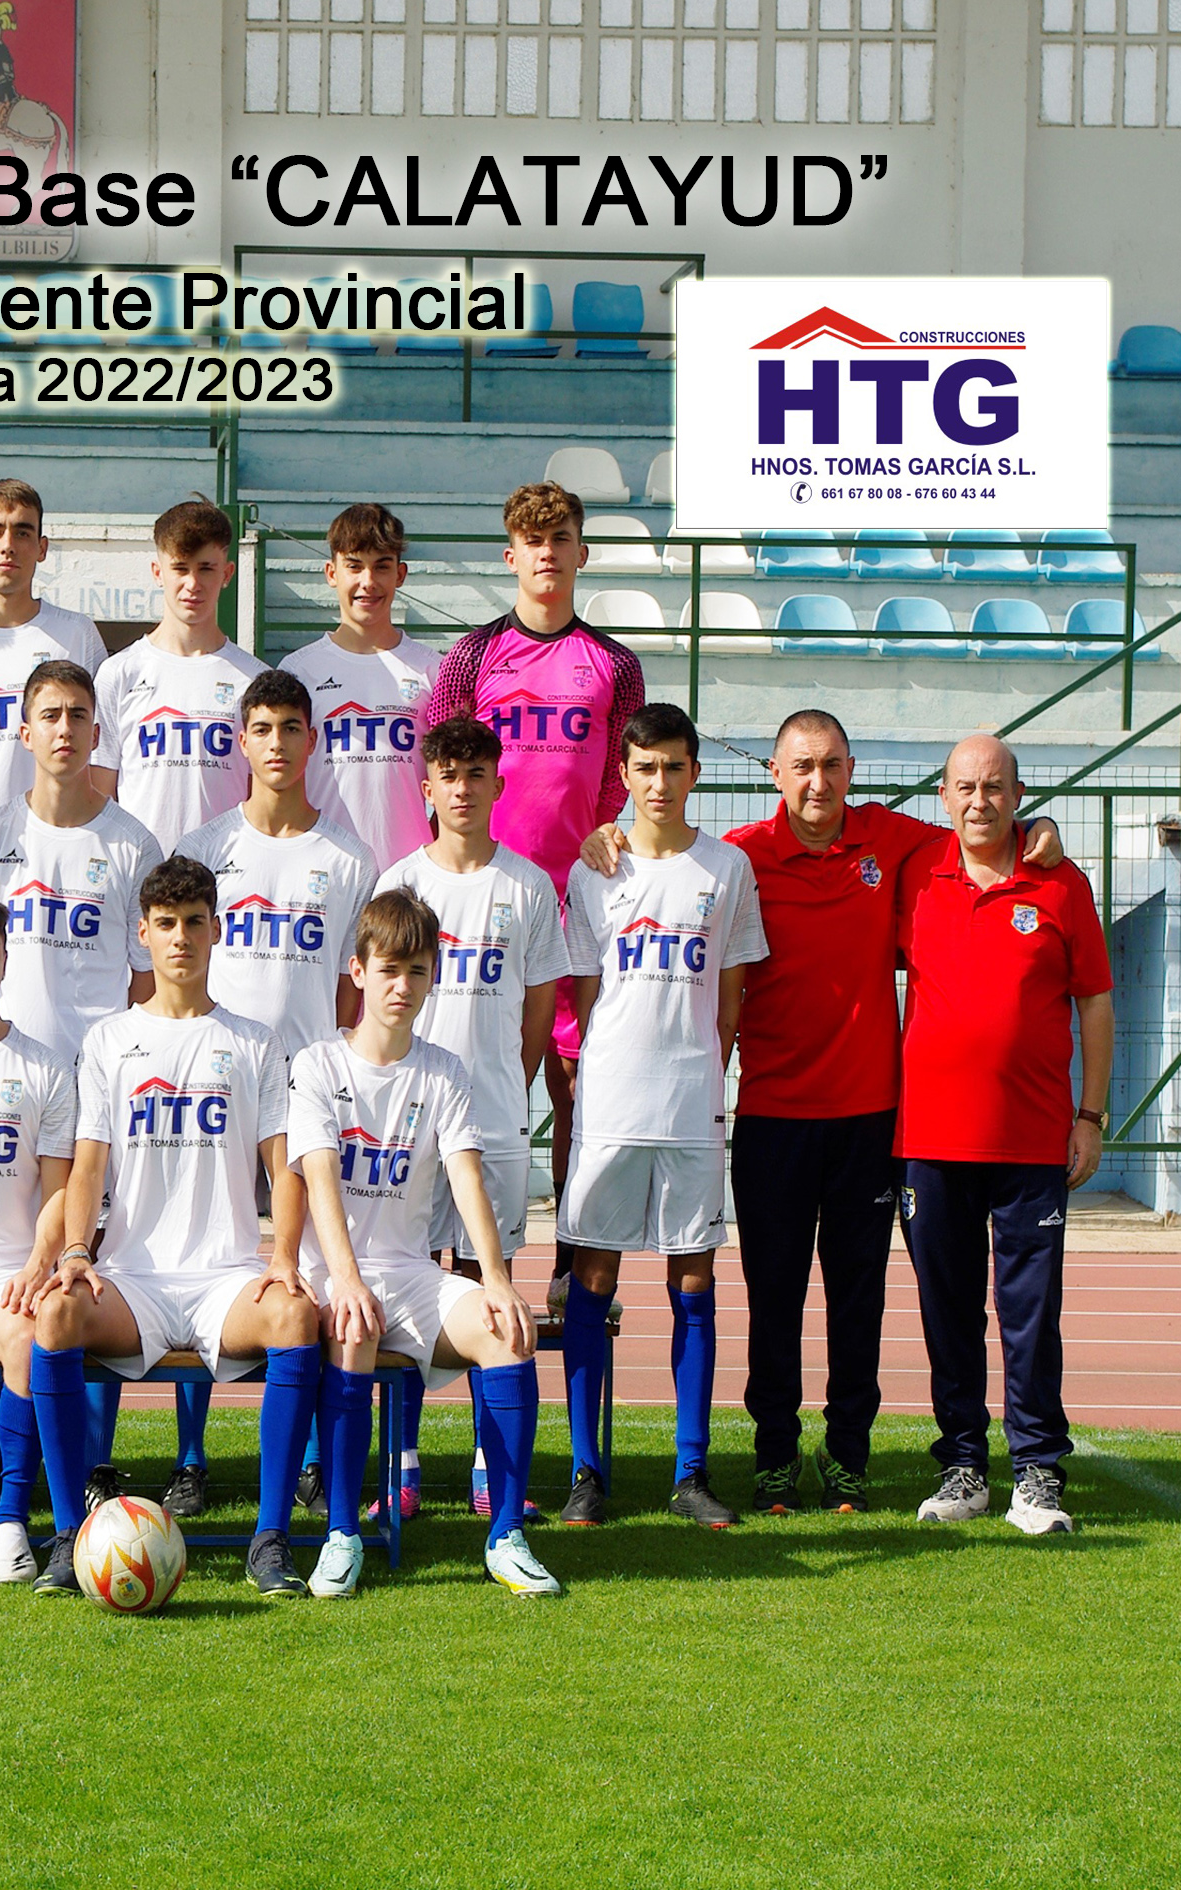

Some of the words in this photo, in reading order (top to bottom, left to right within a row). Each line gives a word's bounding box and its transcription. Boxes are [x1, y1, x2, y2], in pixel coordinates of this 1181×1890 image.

[139, 721, 233, 758] HTG
[324, 717, 415, 753] HTG
[491, 706, 592, 741] HTG
[517, 744, 544, 753] TOMAS
[7, 898, 101, 938] HTG
[226, 912, 325, 951] HTG
[29, 937, 52, 947] TOMAS
[248, 952, 277, 961] TOMAS
[617, 934, 706, 973] HTG
[639, 973, 667, 982] TOMAS
[128, 1096, 227, 1137] HTG
[150, 1139, 179, 1149] TOMAS
[346, 1186, 375, 1198] TOMAS
